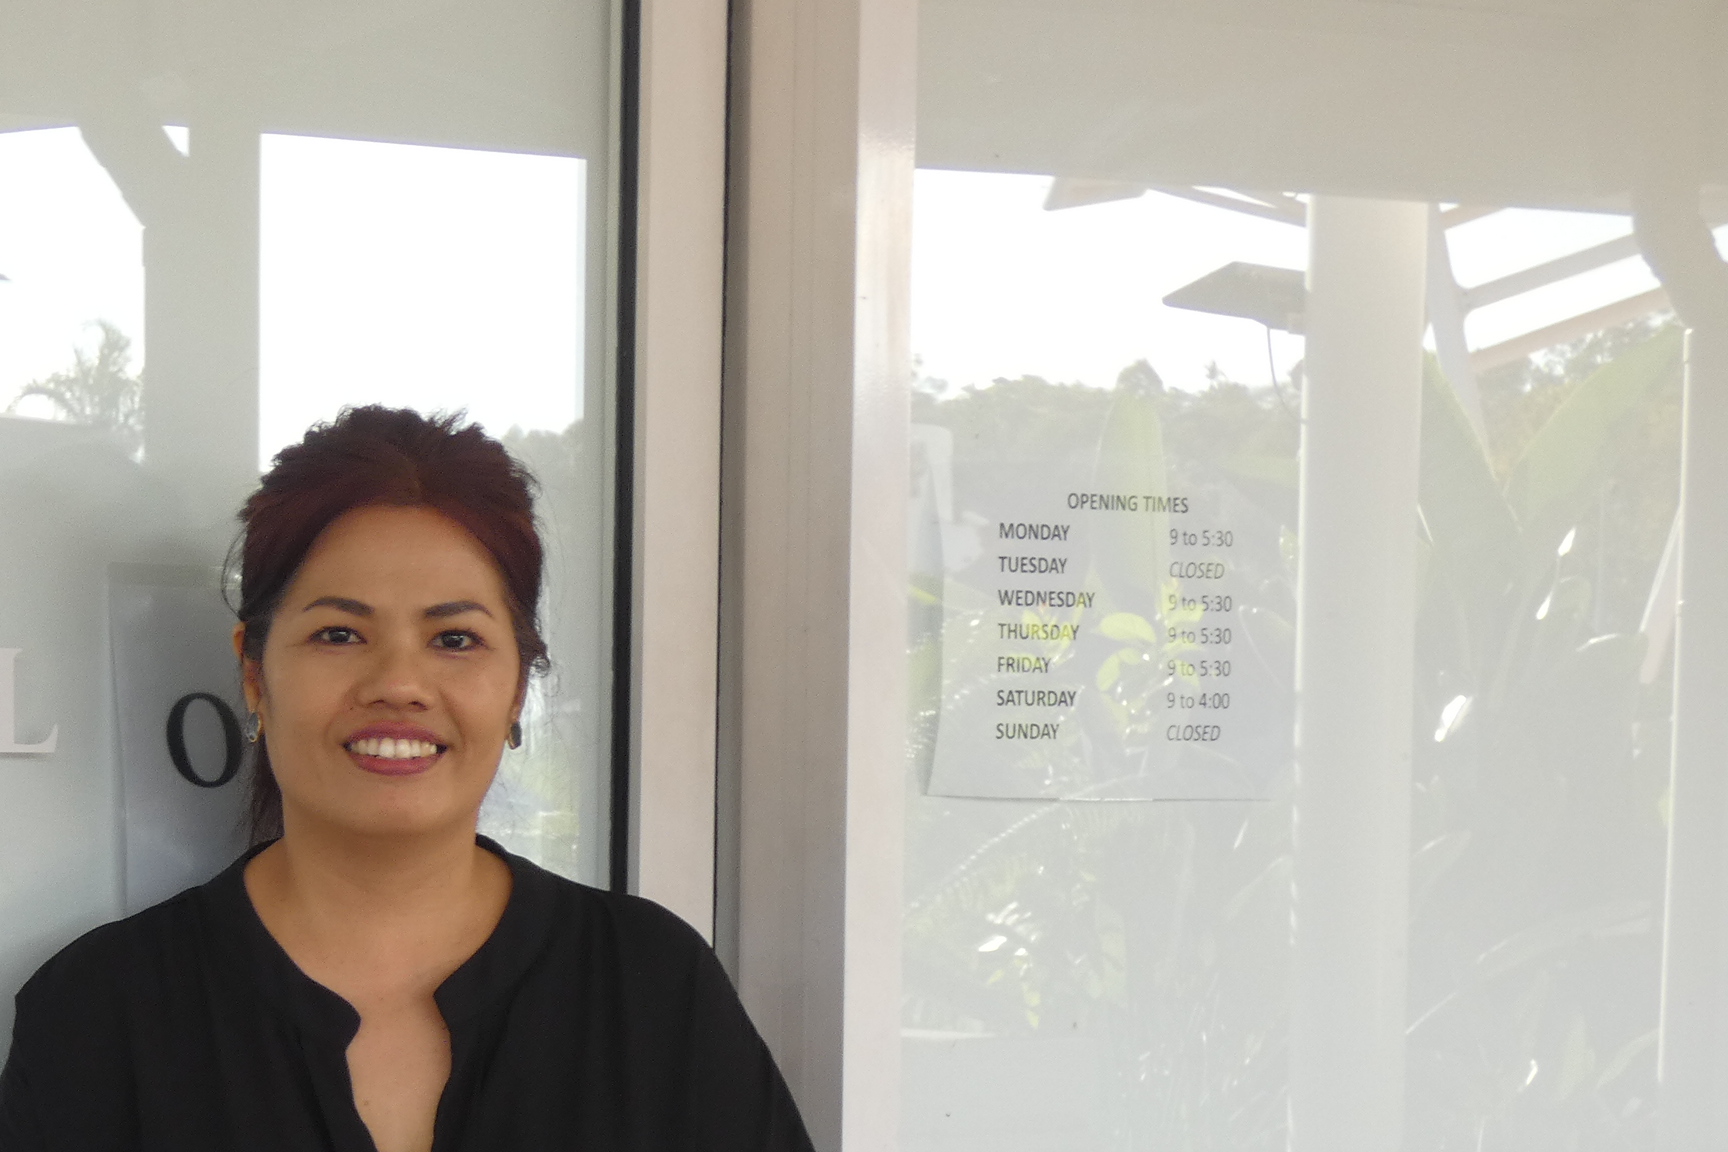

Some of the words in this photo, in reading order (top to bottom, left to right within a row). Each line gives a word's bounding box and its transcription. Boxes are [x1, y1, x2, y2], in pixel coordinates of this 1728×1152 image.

[1067, 493, 1138, 512] OPENING
[1143, 496, 1188, 513] TIMES
[999, 523, 1070, 541] MONDAY
[1169, 529, 1177, 545] 9
[1183, 530, 1197, 545] to
[1202, 531, 1233, 547] 5:30
[999, 557, 1067, 574] TUESDAY
[1169, 561, 1225, 579] CLOSED
[998, 590, 1095, 607] WEDNESDAY
[1168, 595, 1177, 611] 9
[1182, 596, 1196, 611] to
[1201, 596, 1232, 612] 5:30
[999, 623, 1079, 641] THURSDAY
[1168, 627, 1177, 643] 9
[1181, 629, 1196, 644] to
[1200, 628, 1232, 645] 5:30
[998, 657, 1050, 674] FRIDAY
[1168, 660, 1176, 676] 9
[1181, 661, 1195, 676] to
[1200, 661, 1231, 677] 5:30
[997, 690, 1076, 707] SATURDAY
[1167, 693, 1175, 708] 9
[1180, 694, 1194, 708] to
[1199, 693, 1230, 709] 4:00
[996, 723, 1059, 740] SUNDAY
[1167, 725, 1221, 741] CLOSED
